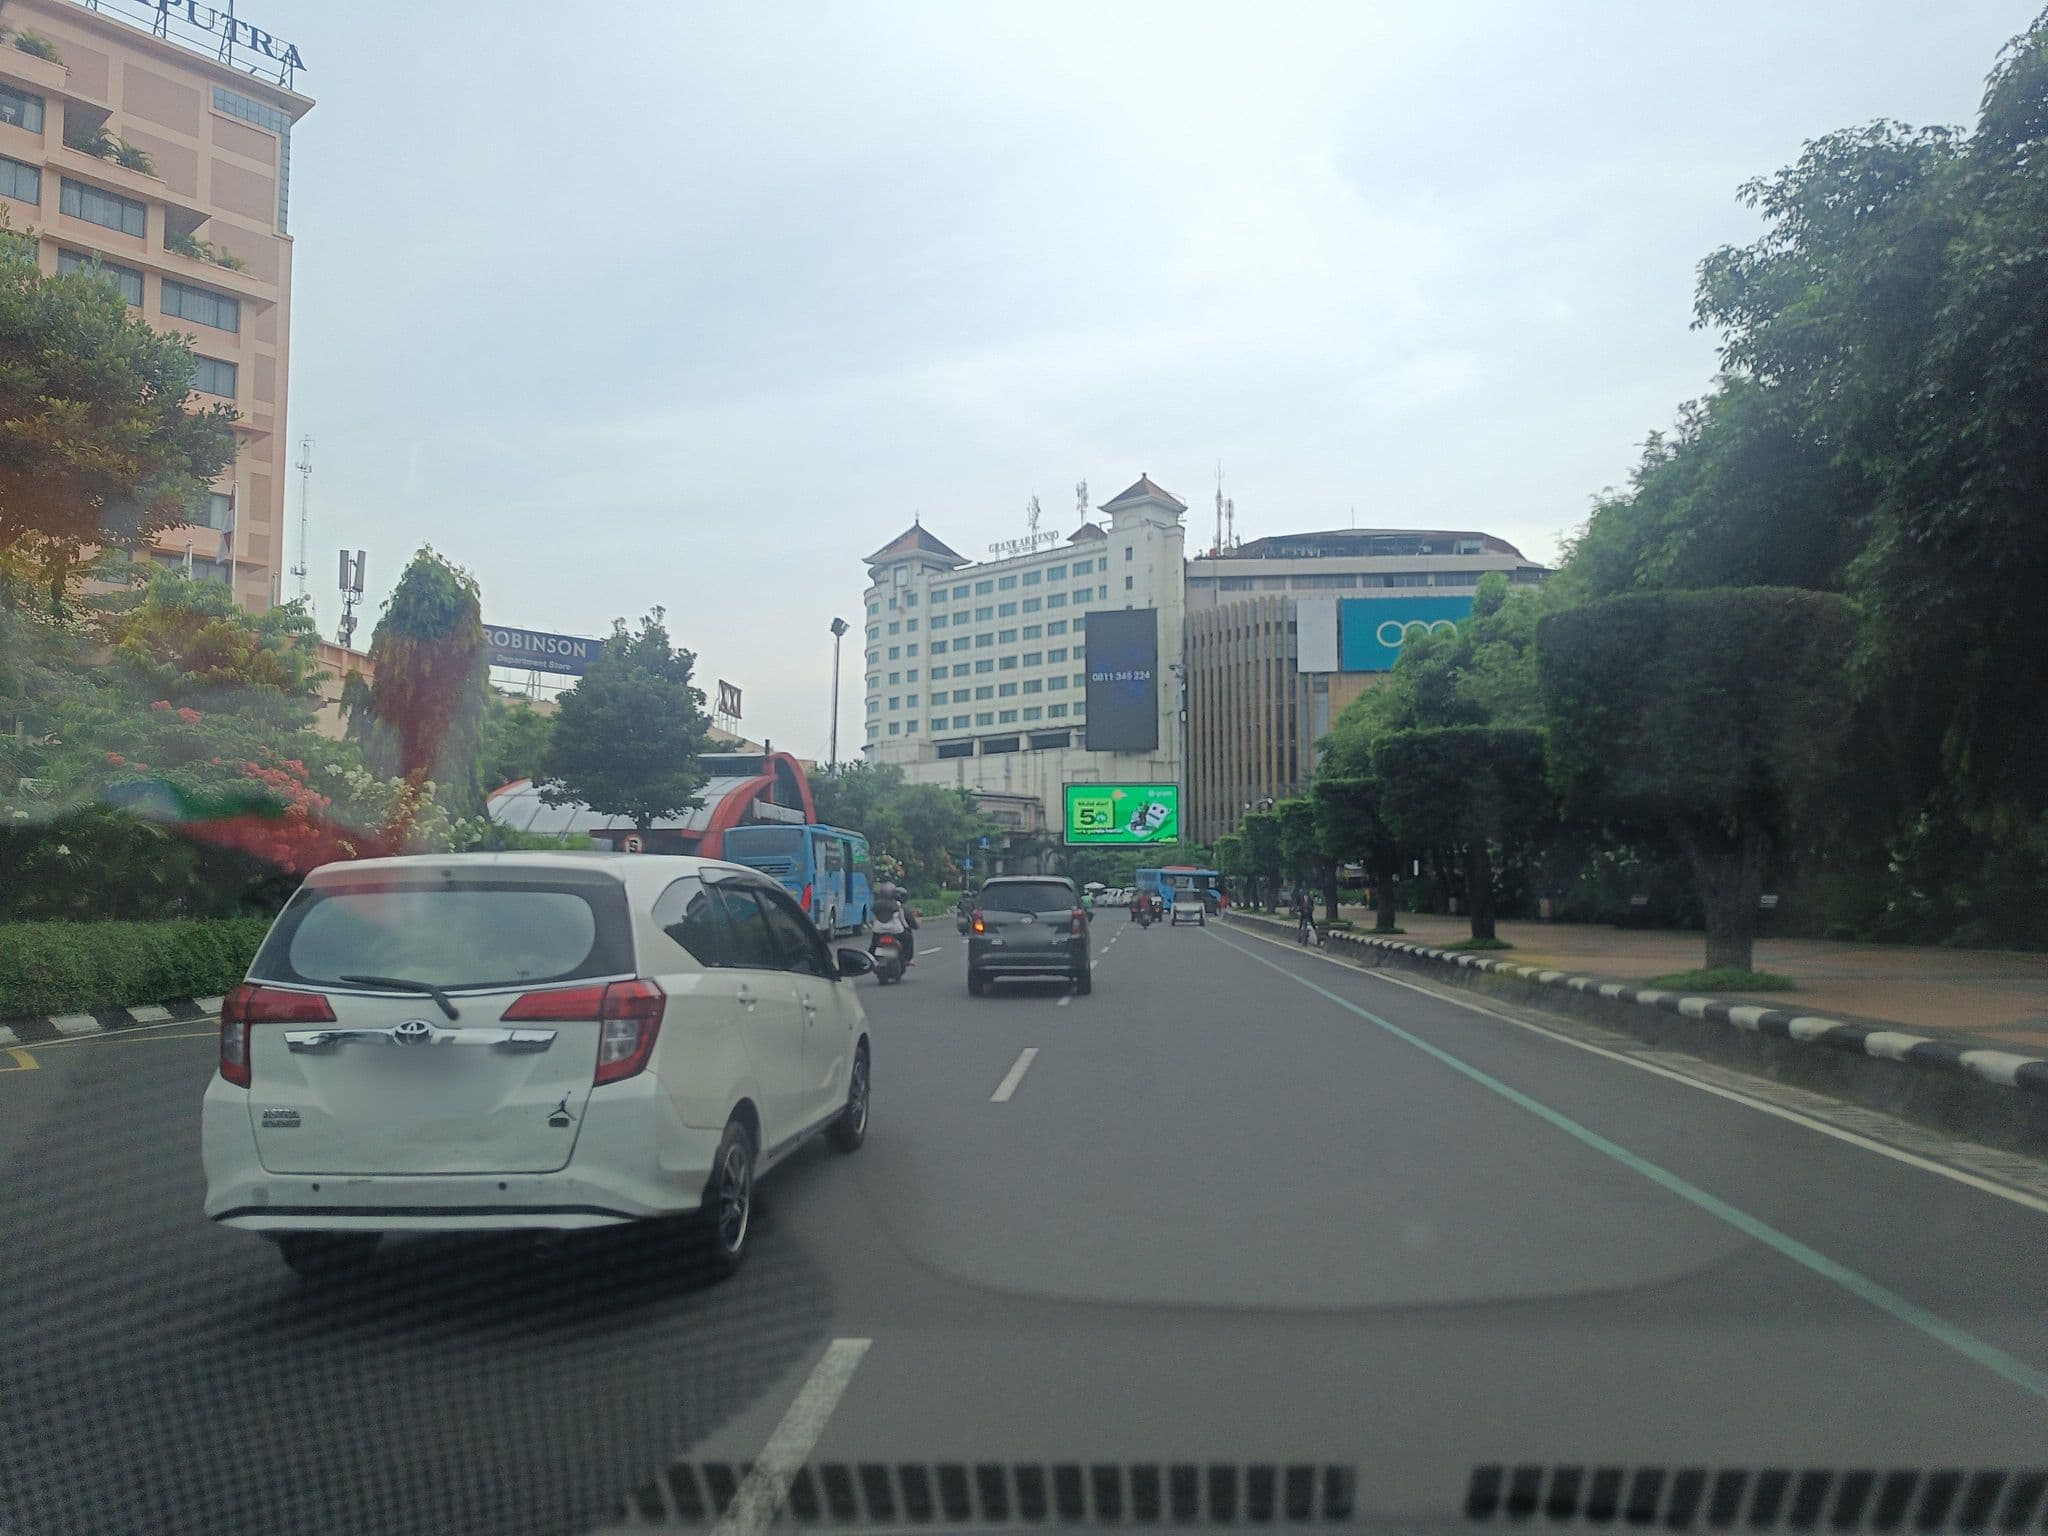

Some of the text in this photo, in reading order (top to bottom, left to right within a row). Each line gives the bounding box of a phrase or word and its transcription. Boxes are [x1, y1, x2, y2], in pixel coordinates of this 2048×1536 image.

[134, 0, 307, 71] PUTRA
[482, 628, 586, 658] ROBINSON
[496, 654, 572, 671] Department Store
